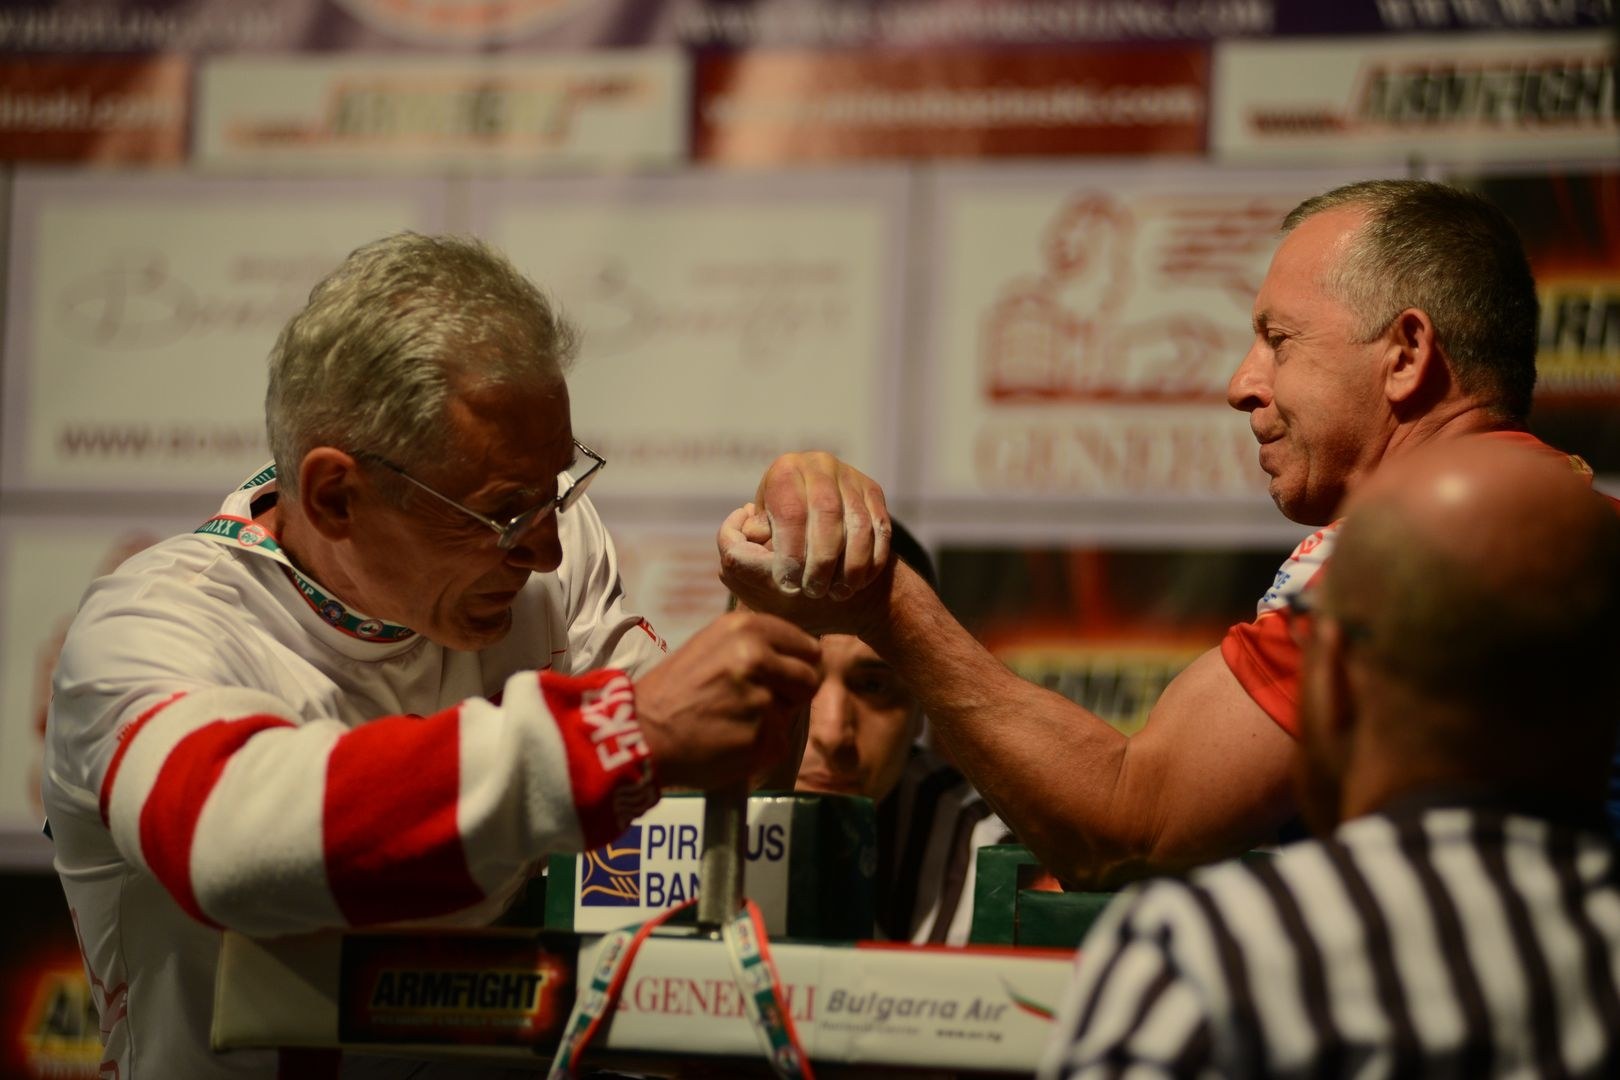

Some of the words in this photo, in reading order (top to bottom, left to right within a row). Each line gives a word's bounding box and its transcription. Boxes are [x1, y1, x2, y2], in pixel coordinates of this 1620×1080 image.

[647, 824, 785, 862] PIRUS
[646, 872, 701, 908] BAN
[372, 971, 543, 1009] ARMFIGHT
[634, 976, 817, 1022] GENELI
[826, 989, 959, 1022] Bulgaria
[963, 995, 1008, 1022] Air
